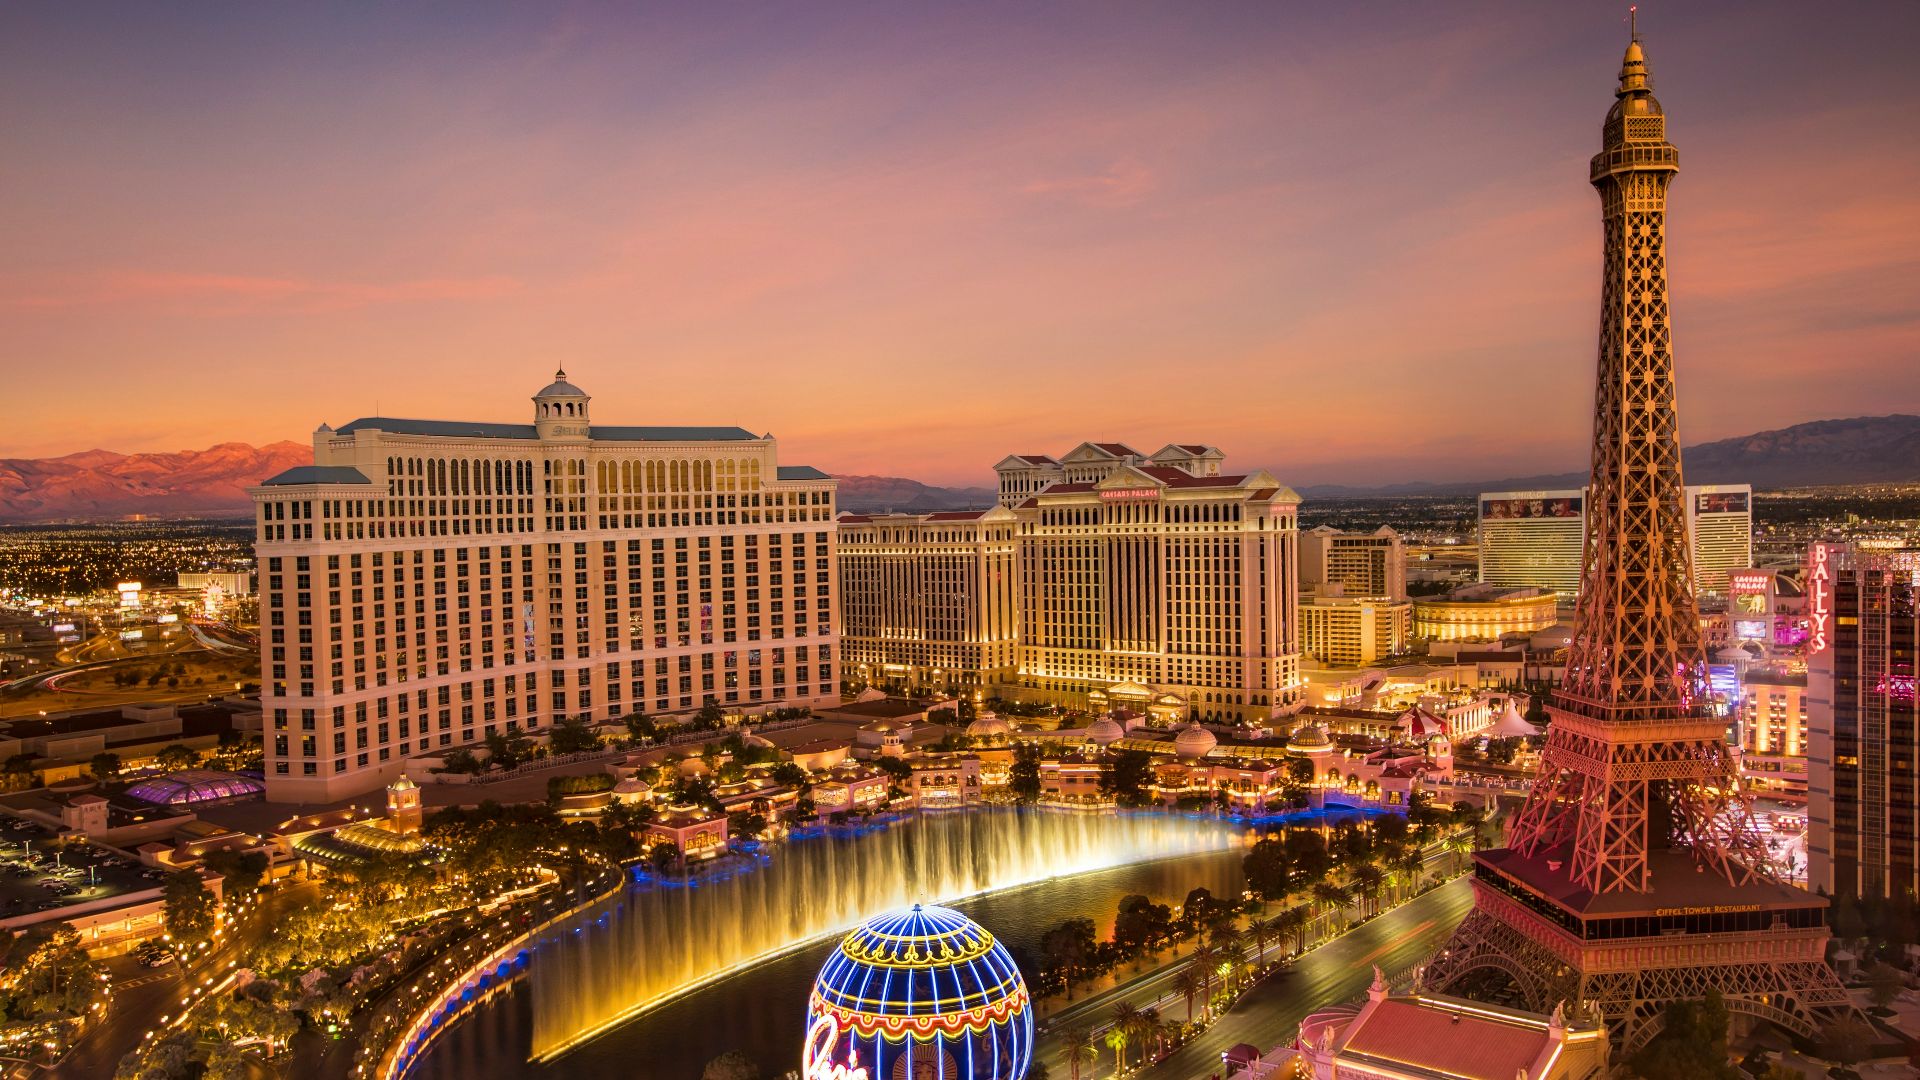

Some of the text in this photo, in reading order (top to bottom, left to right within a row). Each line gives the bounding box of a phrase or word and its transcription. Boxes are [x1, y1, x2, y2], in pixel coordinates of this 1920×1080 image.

[1101, 489, 1158, 498] CAESARS PALACE
[1870, 540, 1905, 548] MIRAGE
[1813, 544, 1829, 650] BALLYS
[1656, 904, 1761, 916] EIFFEL TOWER RESTAURANT
